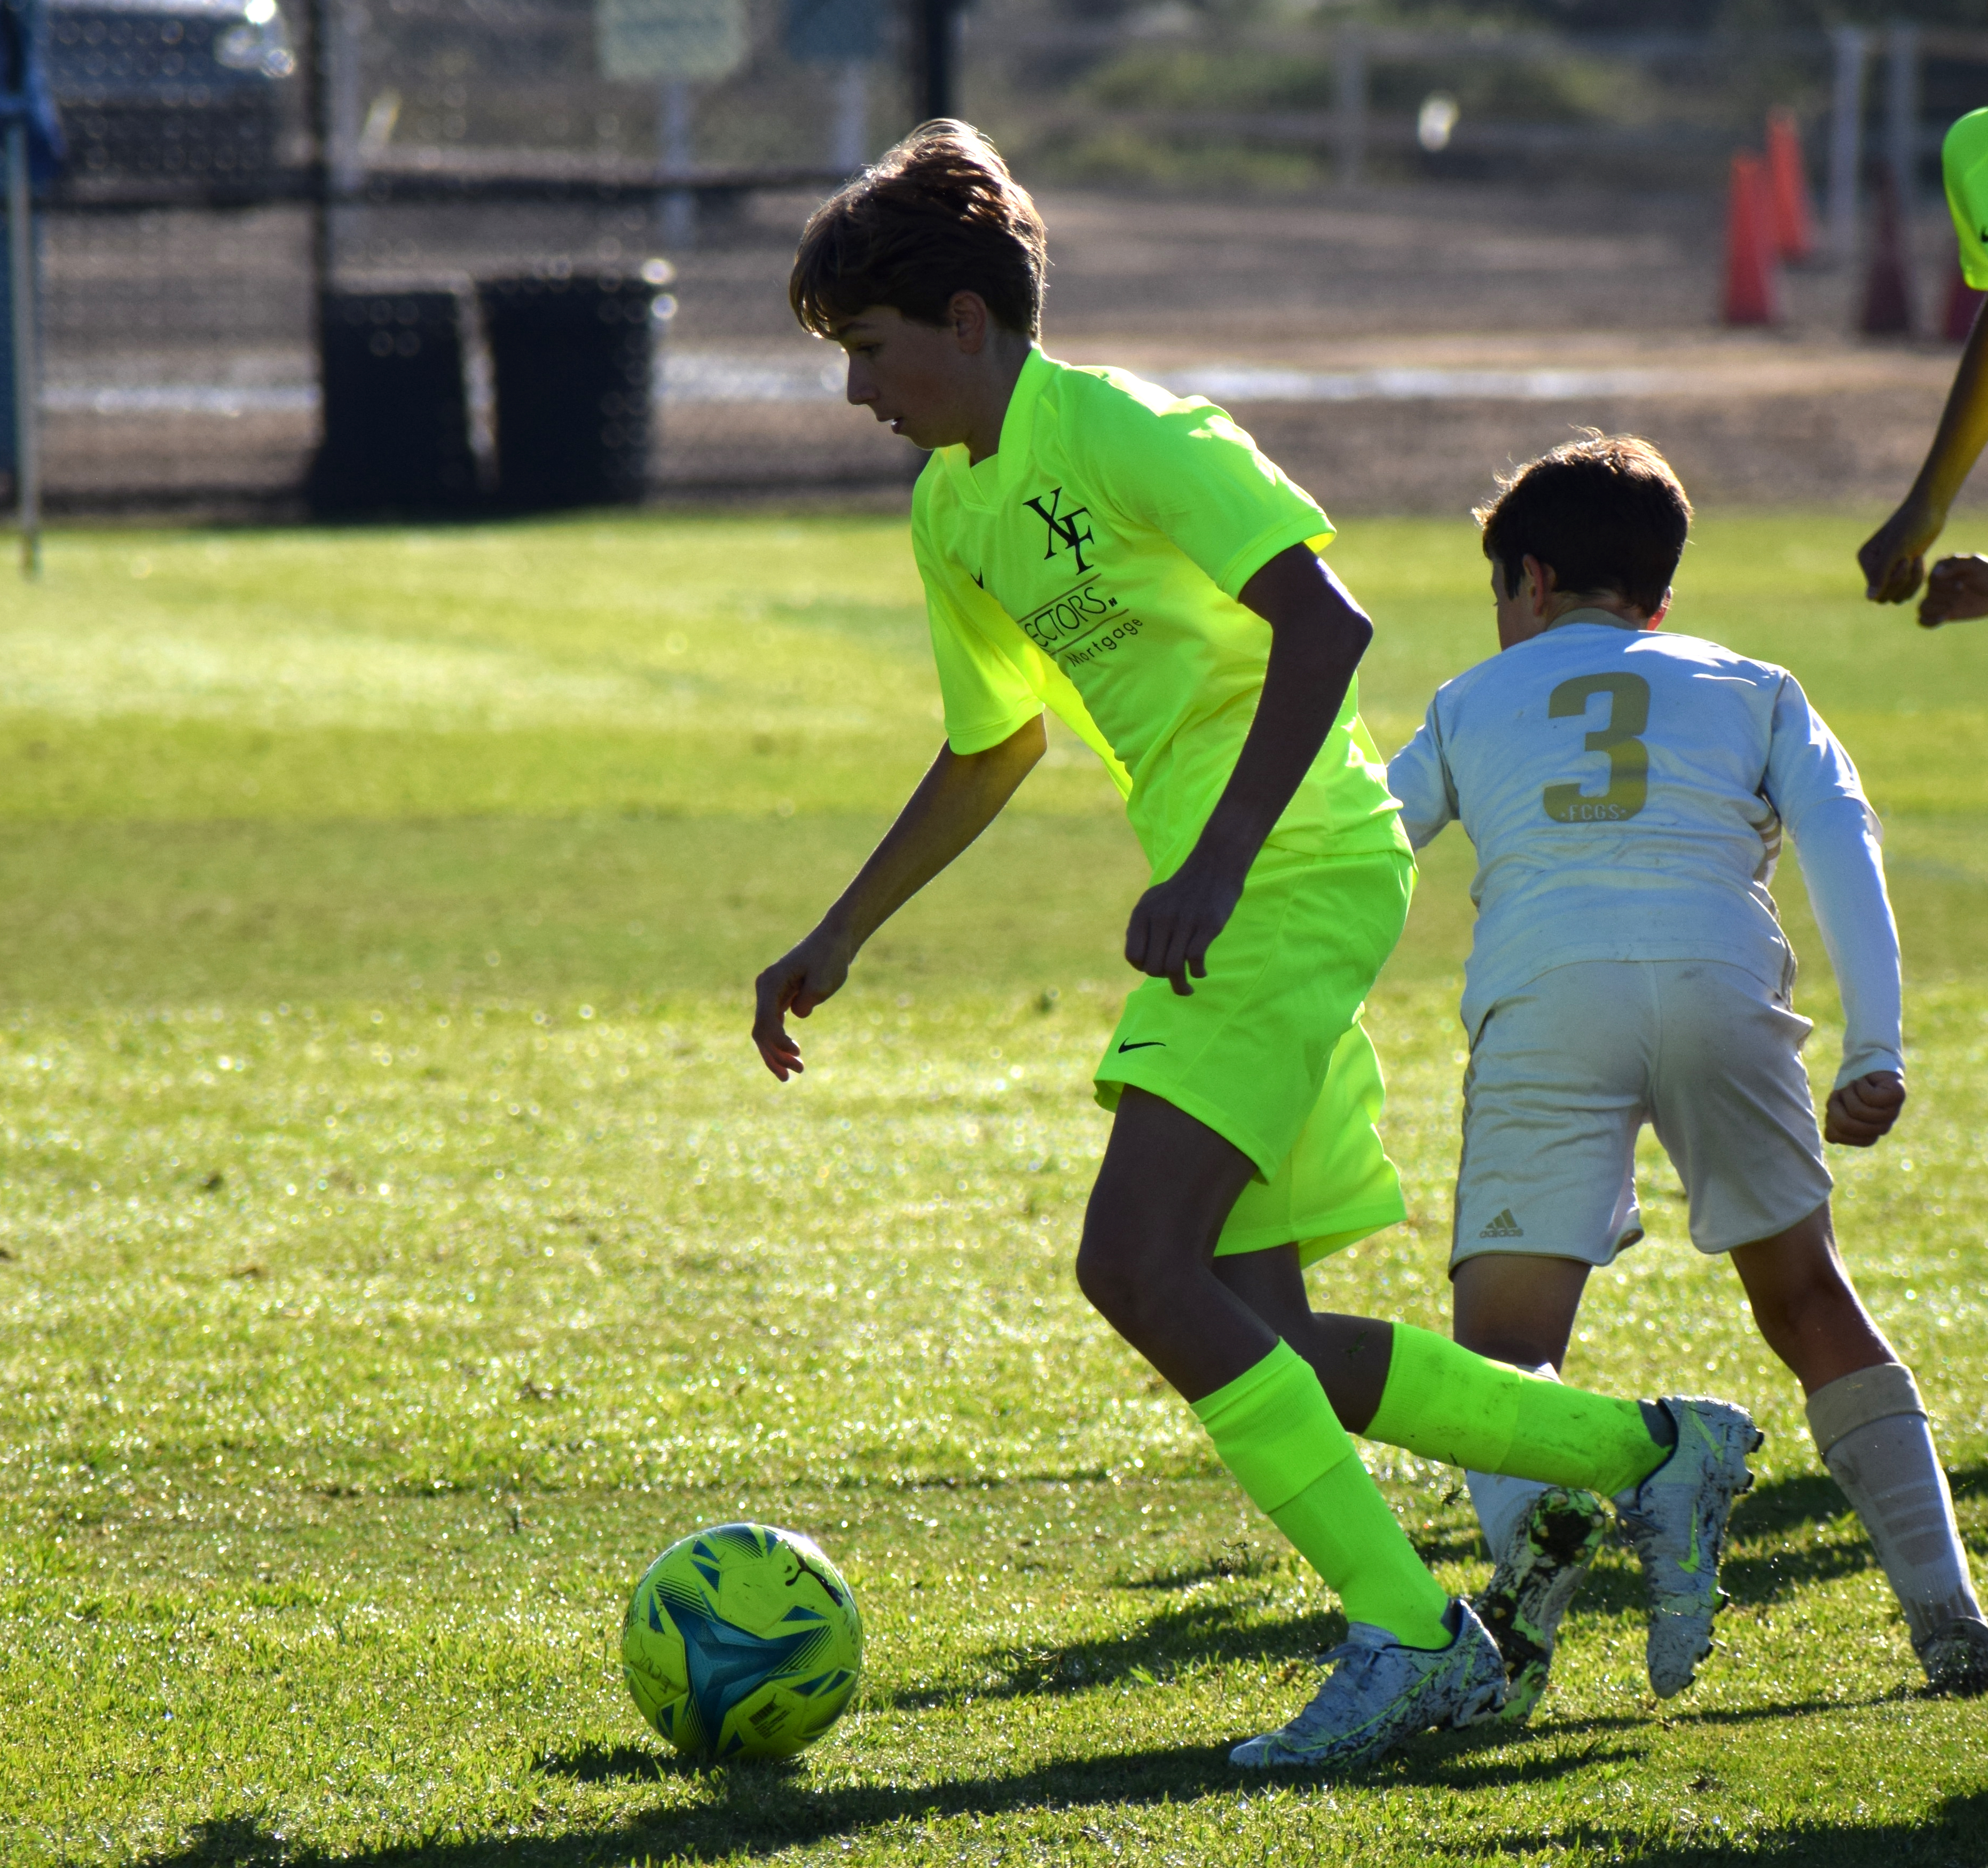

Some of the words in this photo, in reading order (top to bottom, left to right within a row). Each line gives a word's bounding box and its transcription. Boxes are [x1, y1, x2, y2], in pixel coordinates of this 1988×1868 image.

[1024, 587, 1107, 653] ECTORS
[1066, 619, 1143, 667] Mortgage
[1543, 671, 1651, 823] 3
